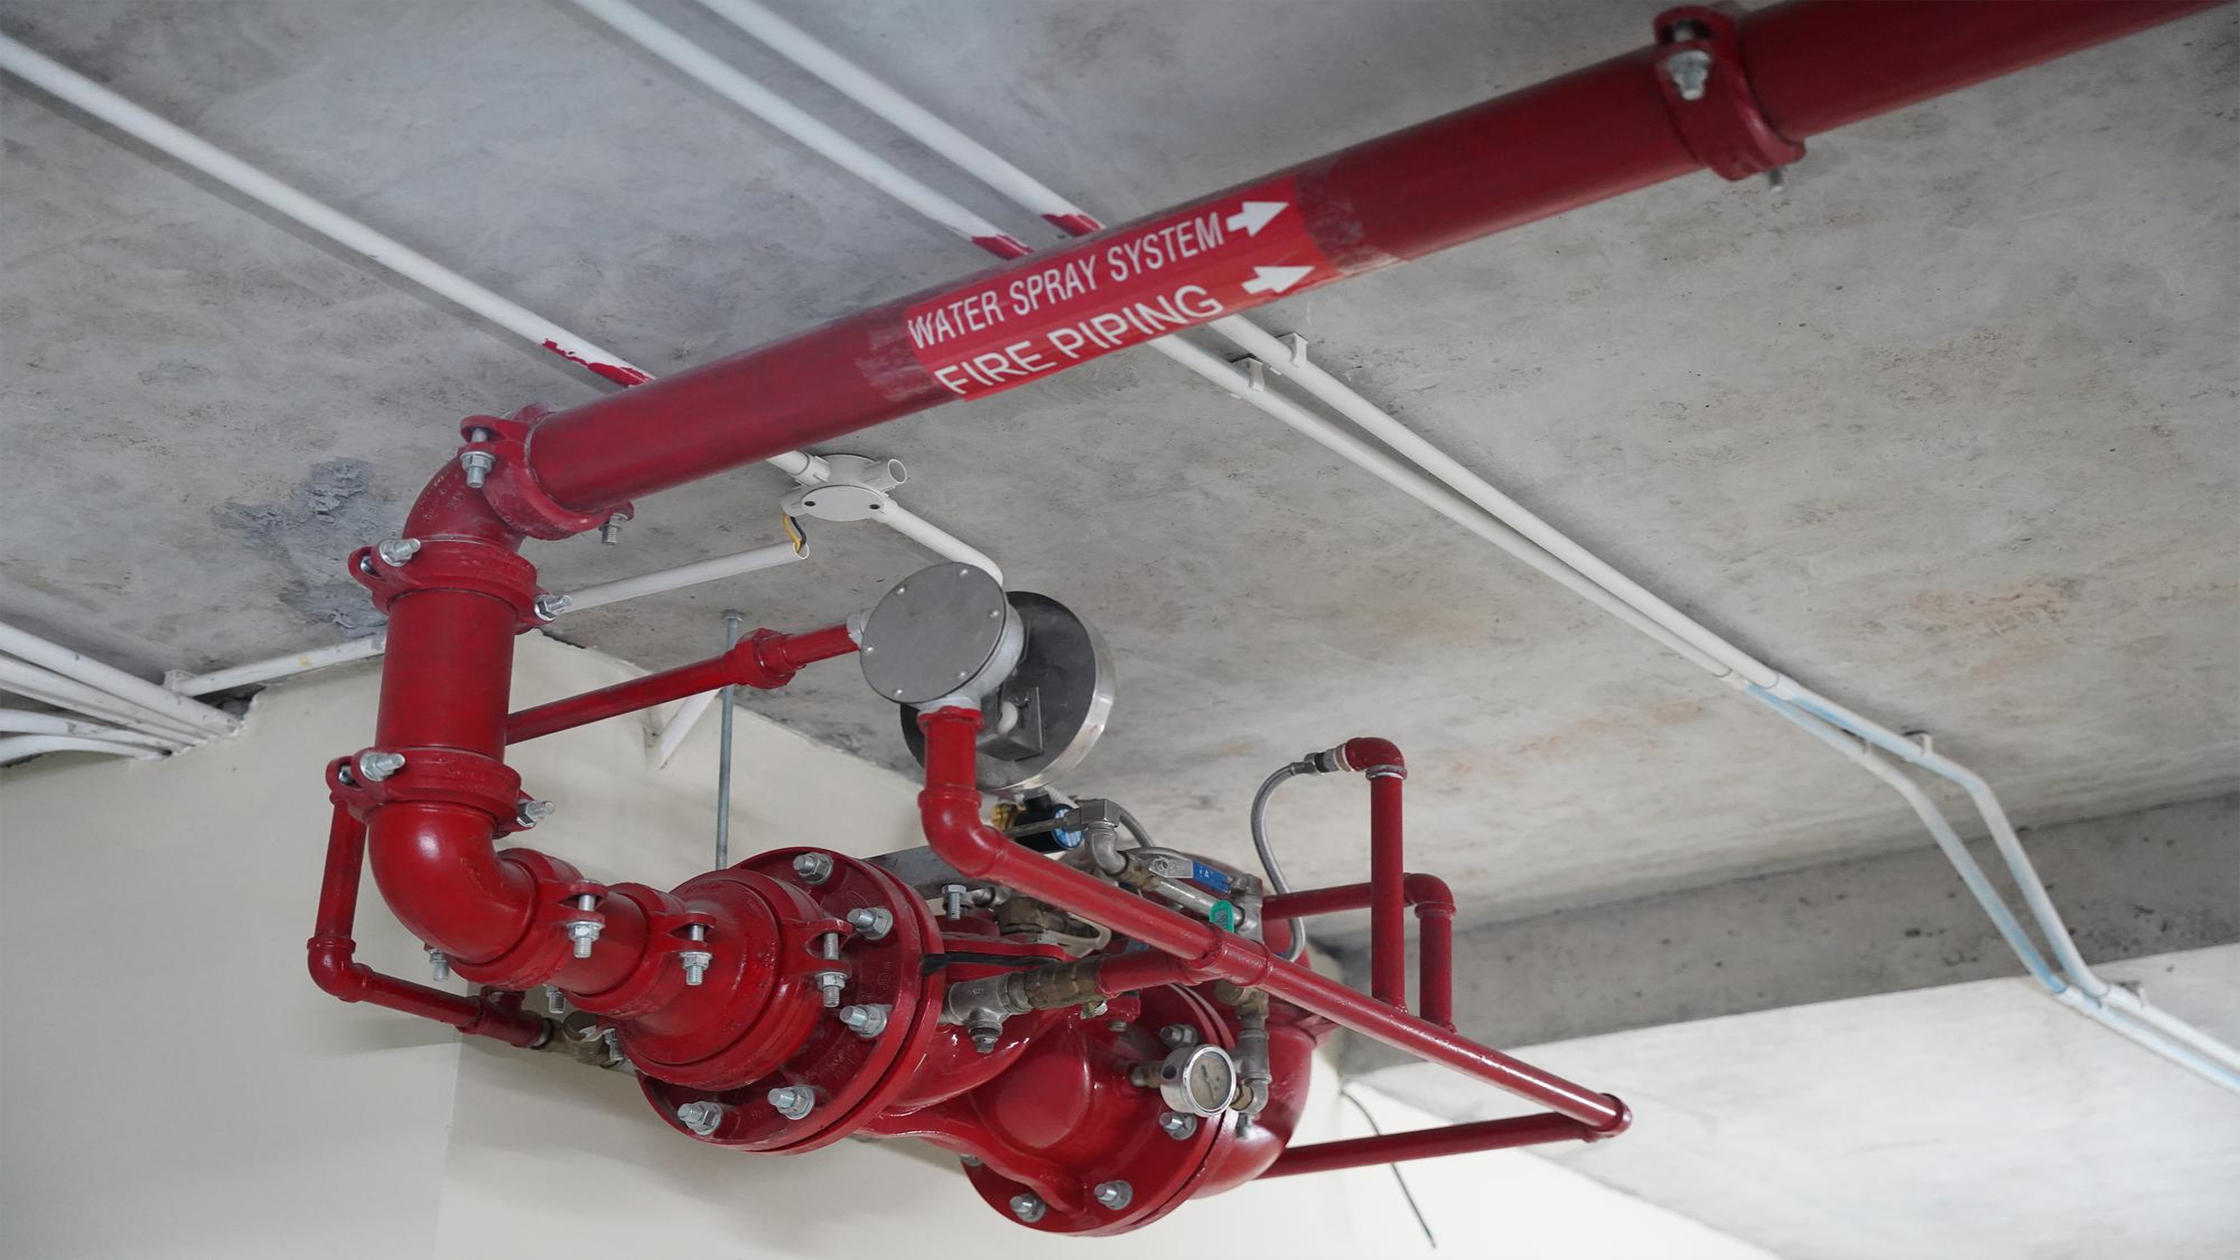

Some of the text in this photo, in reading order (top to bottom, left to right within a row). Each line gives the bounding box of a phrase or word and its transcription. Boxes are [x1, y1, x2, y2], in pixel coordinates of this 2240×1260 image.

[908, 212, 1224, 349] WATER SPRAY SYSTEM
[934, 285, 1224, 394] FIRE PIPING
